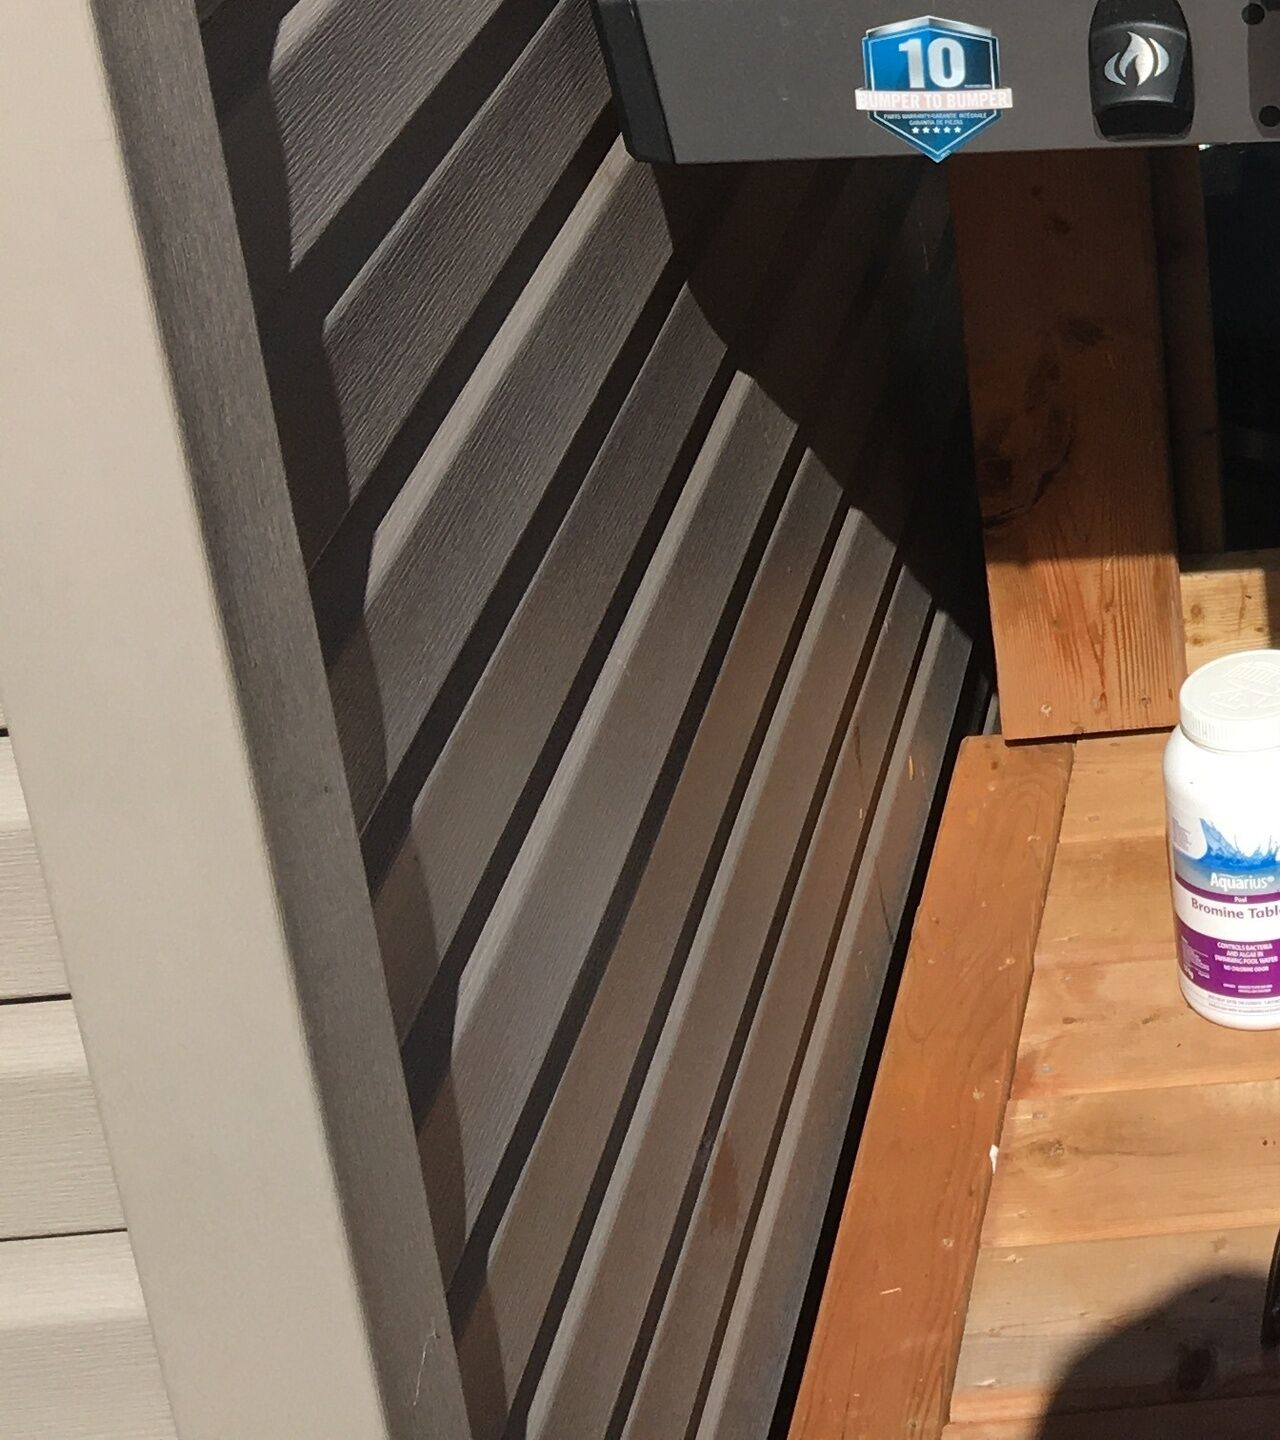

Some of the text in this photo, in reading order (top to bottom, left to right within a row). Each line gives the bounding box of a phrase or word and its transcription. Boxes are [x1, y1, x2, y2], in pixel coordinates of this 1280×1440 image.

[898, 37, 966, 89] 10
[858, 91, 1008, 109] BUMPER TO BUMPER
[1191, 897, 1245, 919] Bromine
